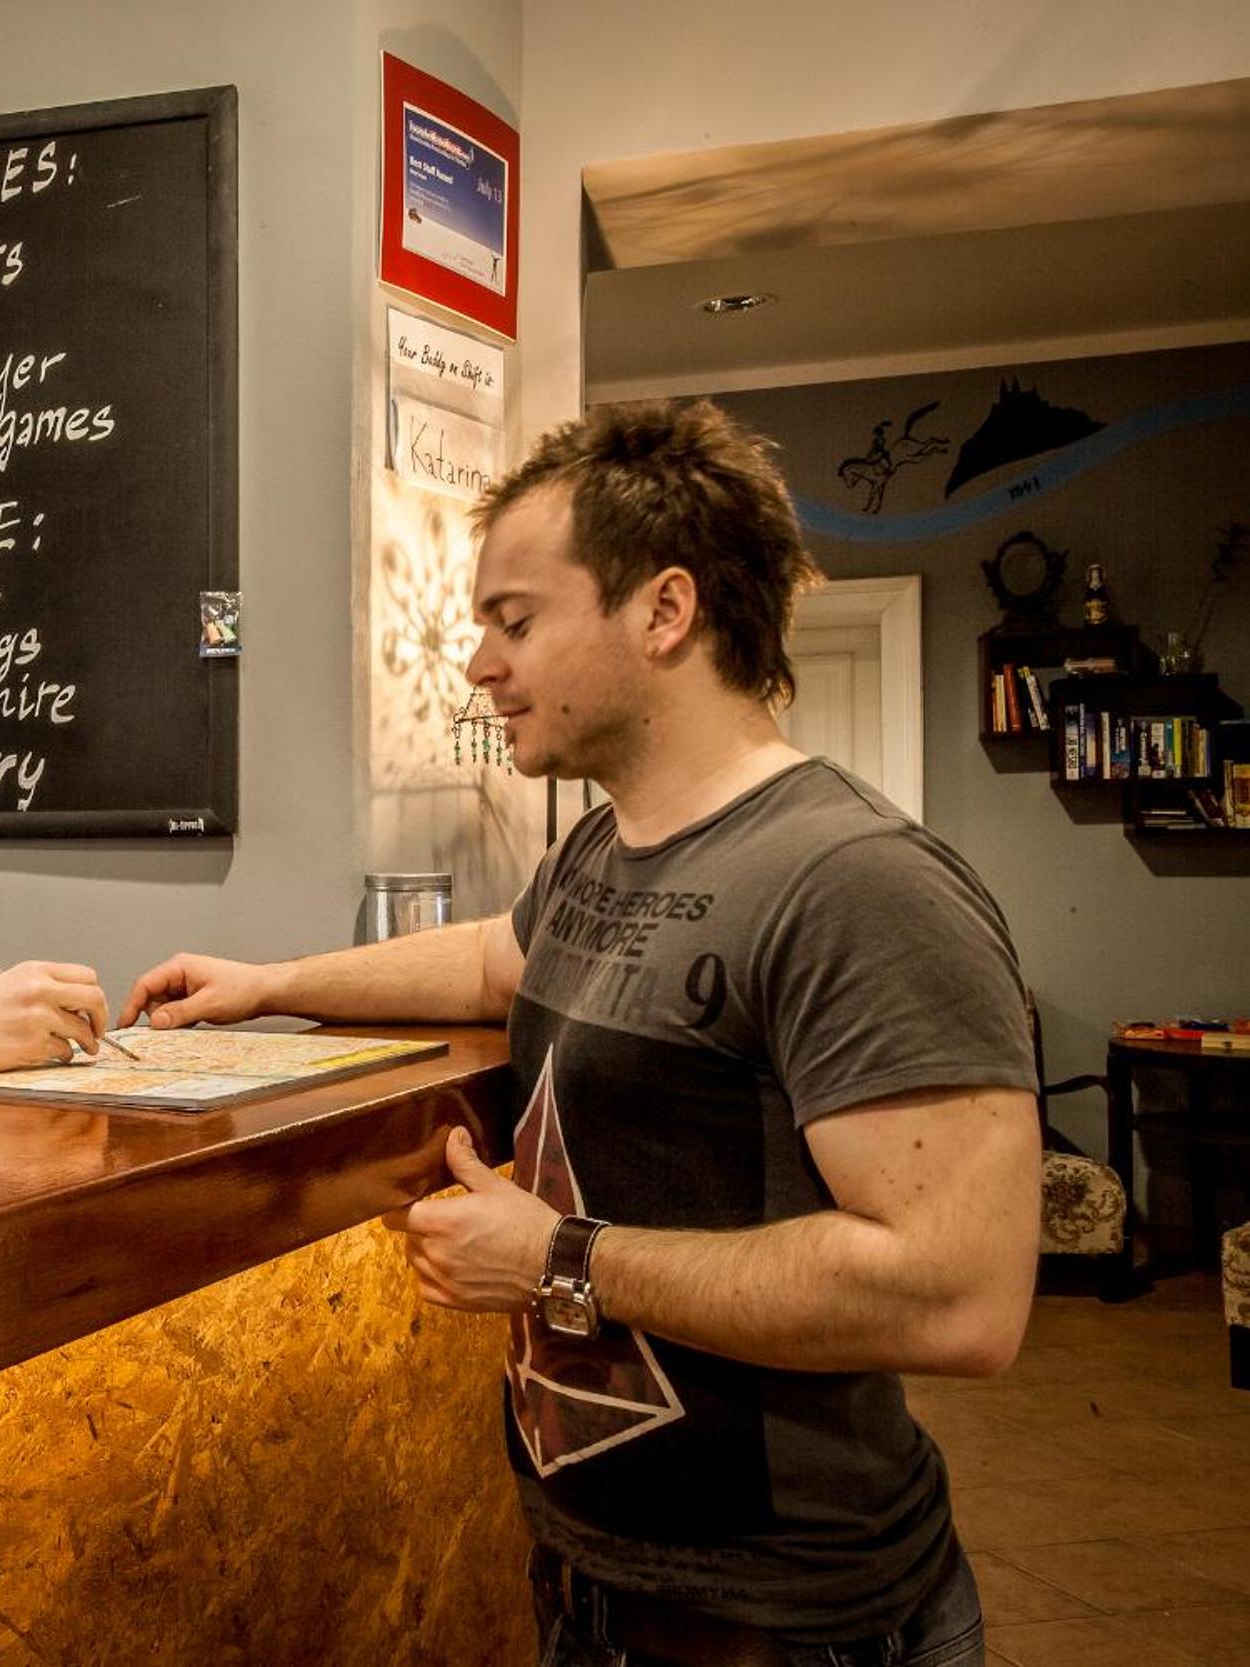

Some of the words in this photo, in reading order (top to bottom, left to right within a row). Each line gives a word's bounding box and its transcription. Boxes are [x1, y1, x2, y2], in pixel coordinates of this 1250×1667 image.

[410, 415, 491, 495] Katarina
[546, 900, 659, 958] ANYMORE
[609, 891, 715, 922] HEROES
[684, 952, 729, 1031] 9
